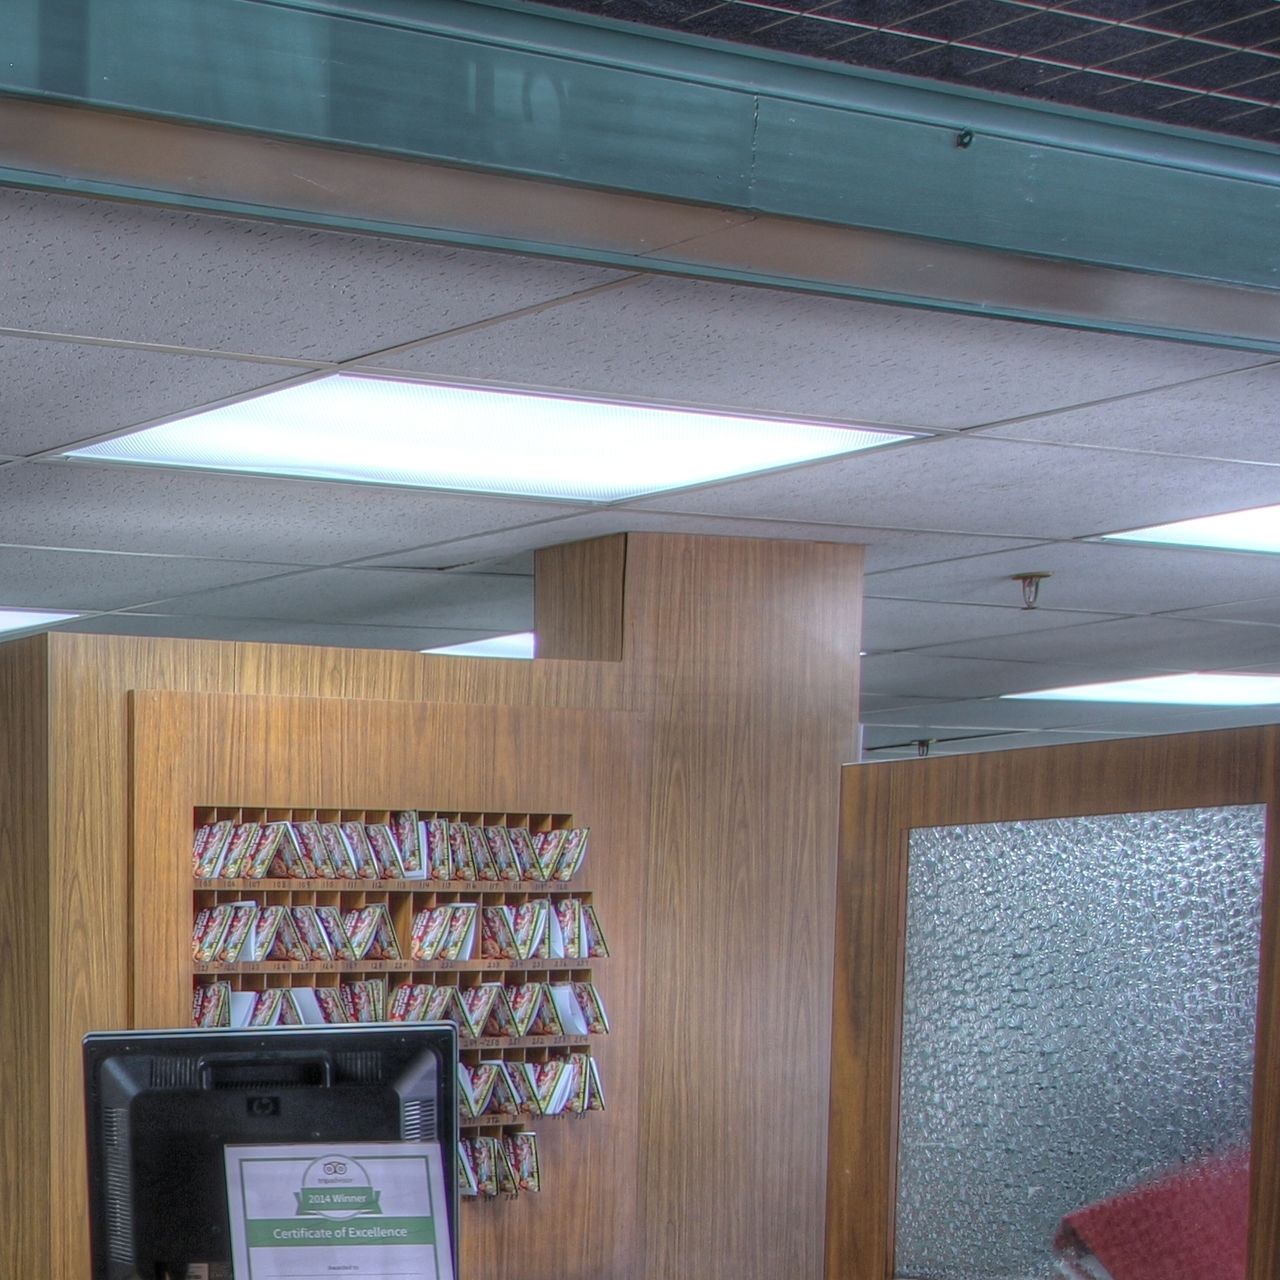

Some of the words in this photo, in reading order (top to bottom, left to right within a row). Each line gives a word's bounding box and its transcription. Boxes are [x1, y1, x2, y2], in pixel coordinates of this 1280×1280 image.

[308, 1194, 332, 1203] 2014
[332, 1193, 368, 1203] Winner
[273, 1227, 333, 1240] Certificate
[334, 1227, 347, 1238] of
[348, 1226, 408, 1238] Excellence
